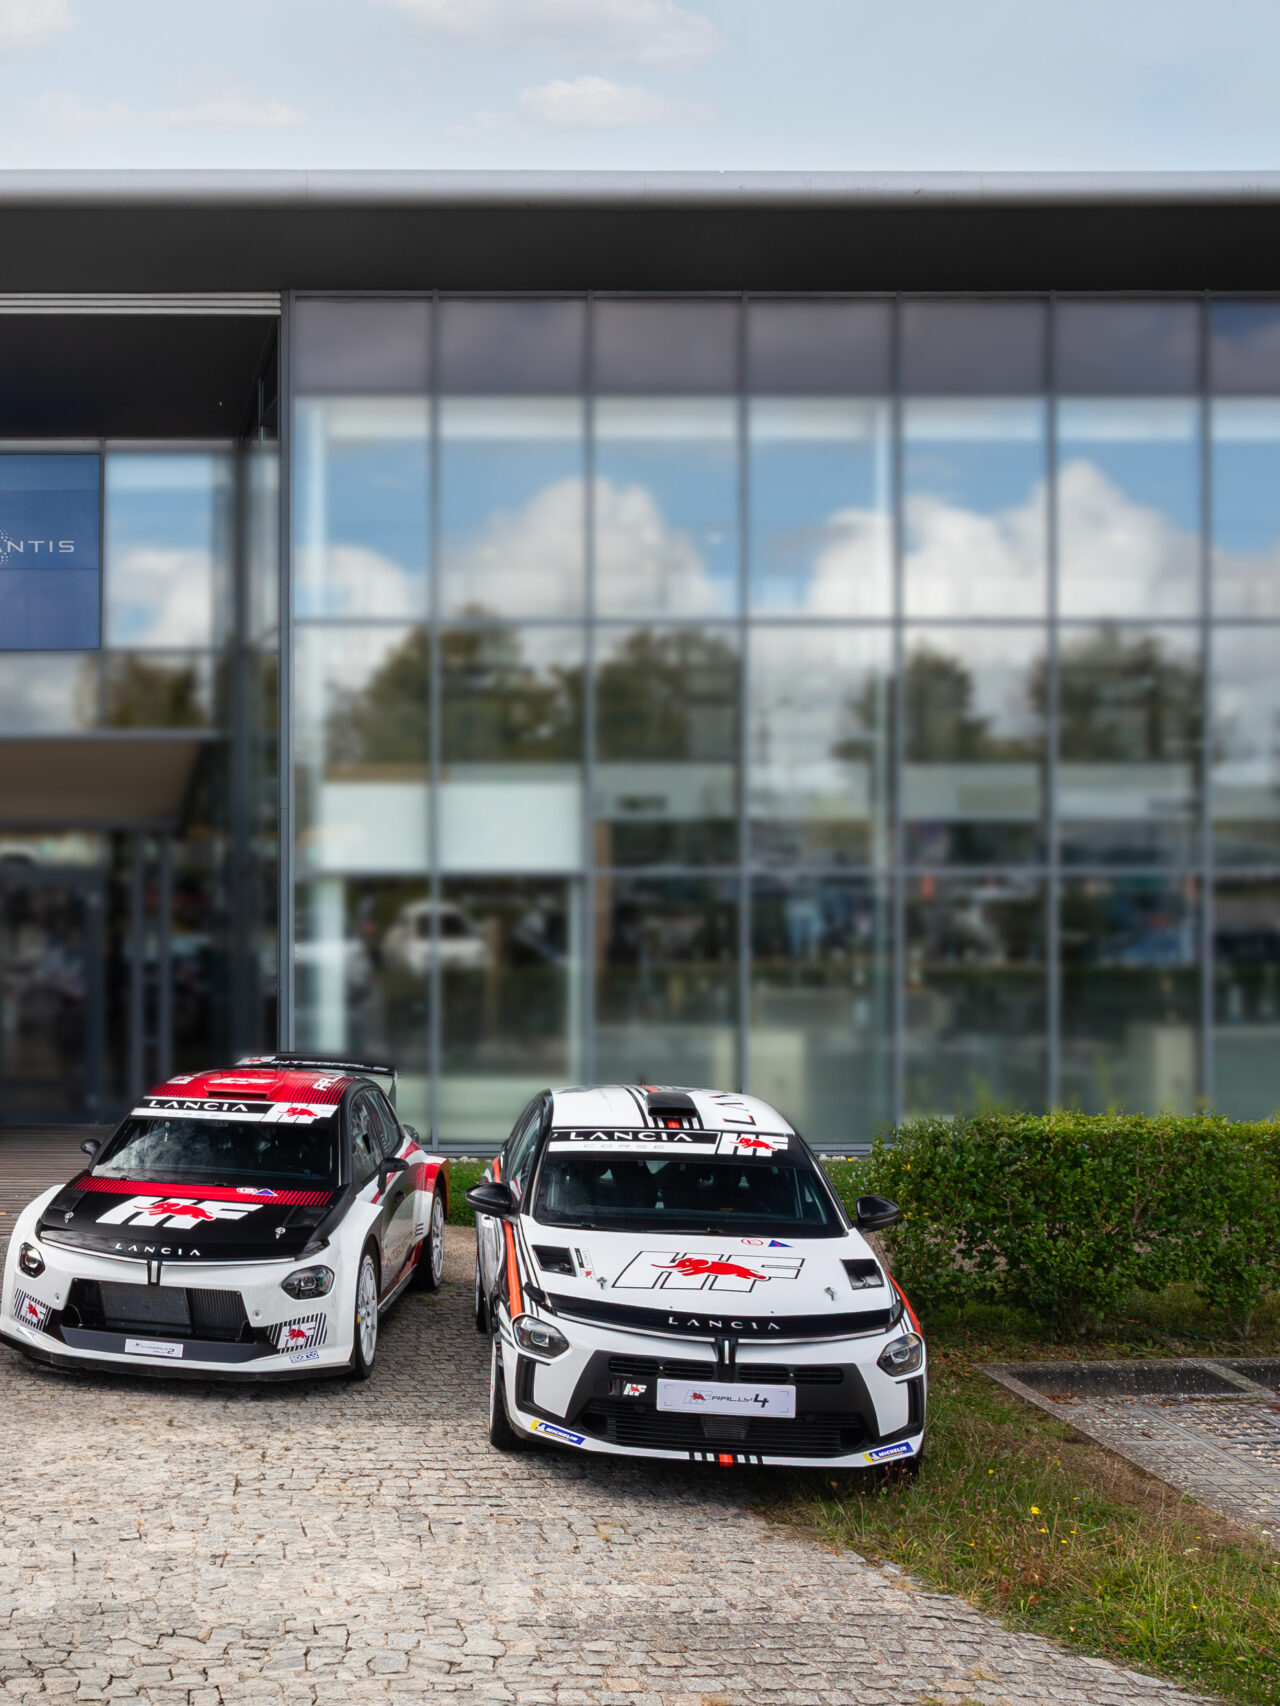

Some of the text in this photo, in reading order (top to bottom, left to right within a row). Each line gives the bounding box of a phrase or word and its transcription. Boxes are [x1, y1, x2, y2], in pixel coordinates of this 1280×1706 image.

[149, 1100, 248, 1111] LANCIA
[569, 1131, 693, 1142] LANCIA
[115, 1243, 201, 1256] LANCIA
[668, 1316, 781, 1330] LANCIA
[878, 1446, 907, 1457] MICHELIN
